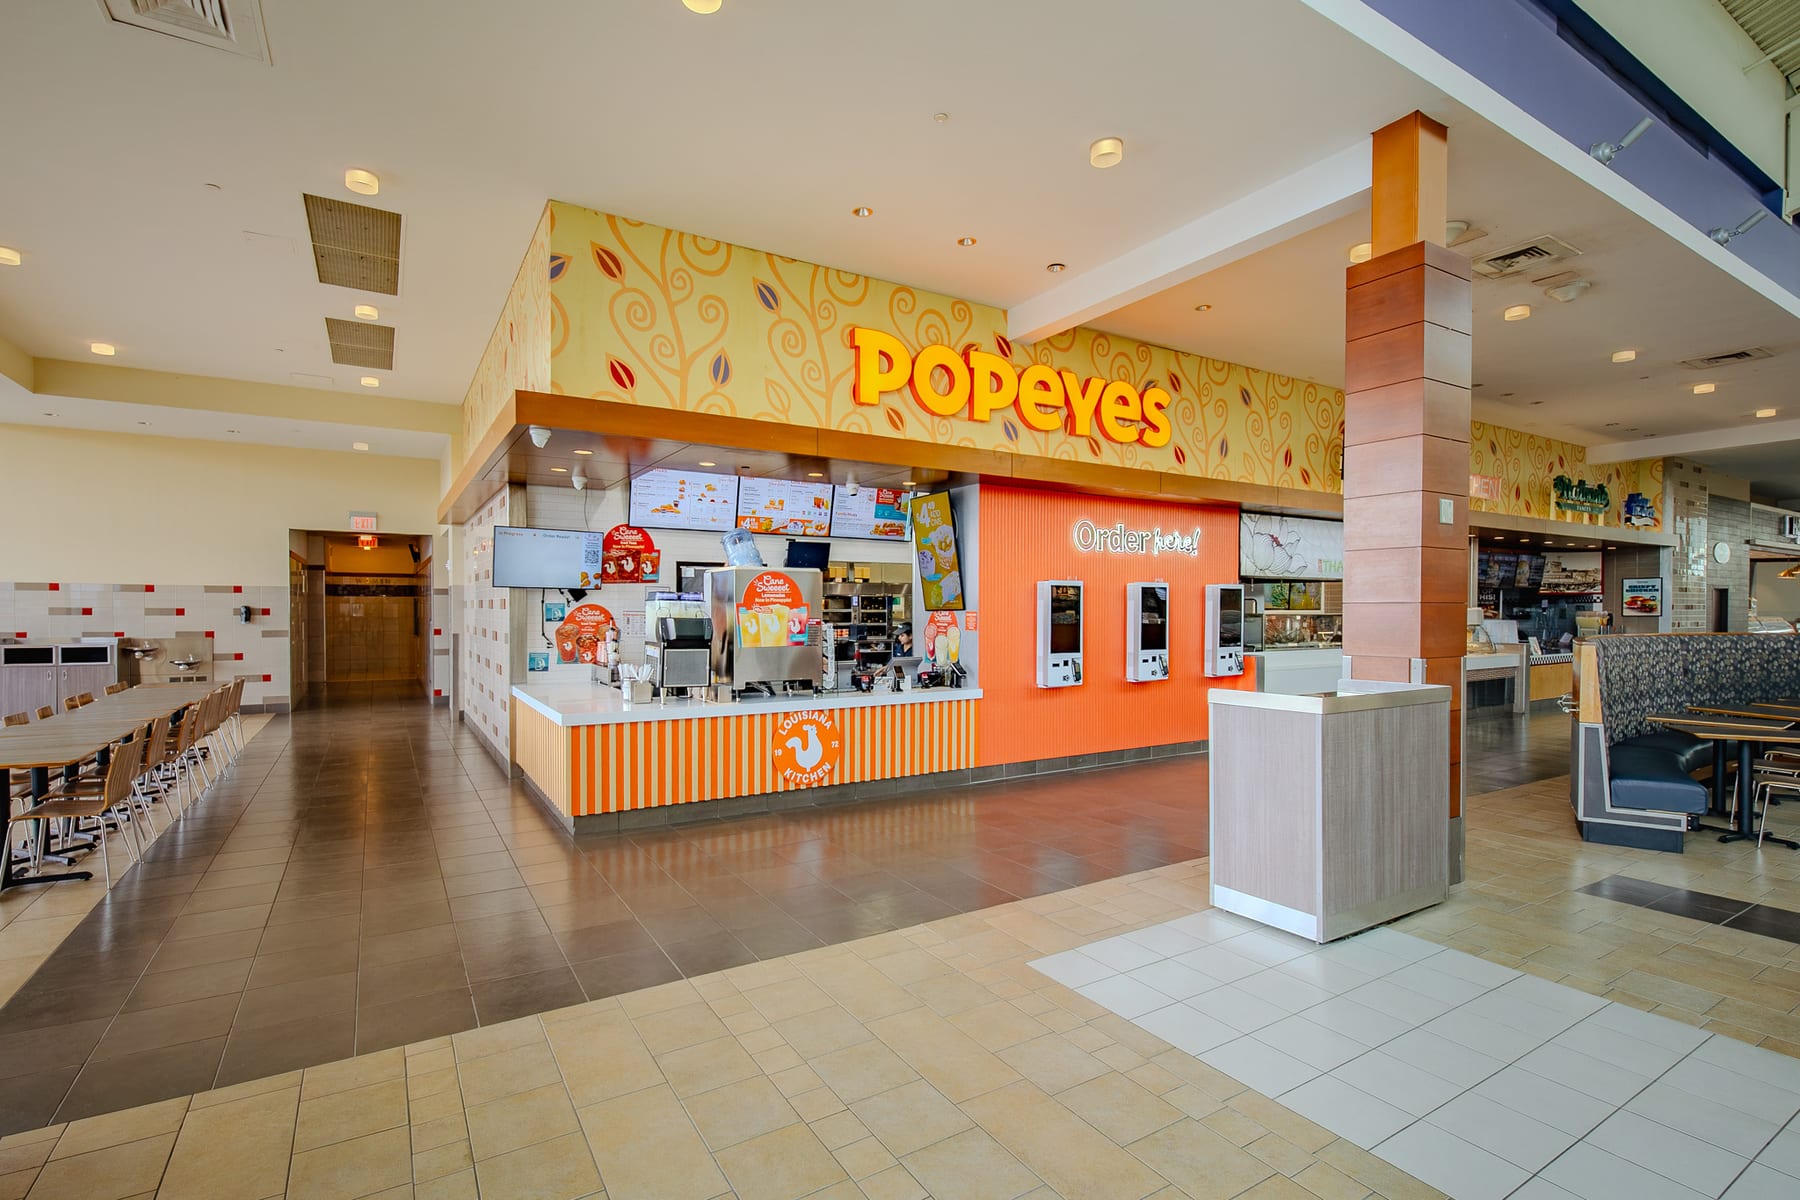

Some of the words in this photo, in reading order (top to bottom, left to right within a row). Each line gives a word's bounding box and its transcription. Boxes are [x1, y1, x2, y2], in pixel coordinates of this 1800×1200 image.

[1469, 475, 1497, 498] HEN
[354, 516, 373, 529] EXIT
[1073, 519, 1151, 553] Order
[1152, 528, 1200, 556] here!
[763, 575, 784, 585] Cane
[779, 711, 832, 736] LOUISIANA
[774, 748, 782, 756] 19
[784, 762, 832, 783] KITCHEN
